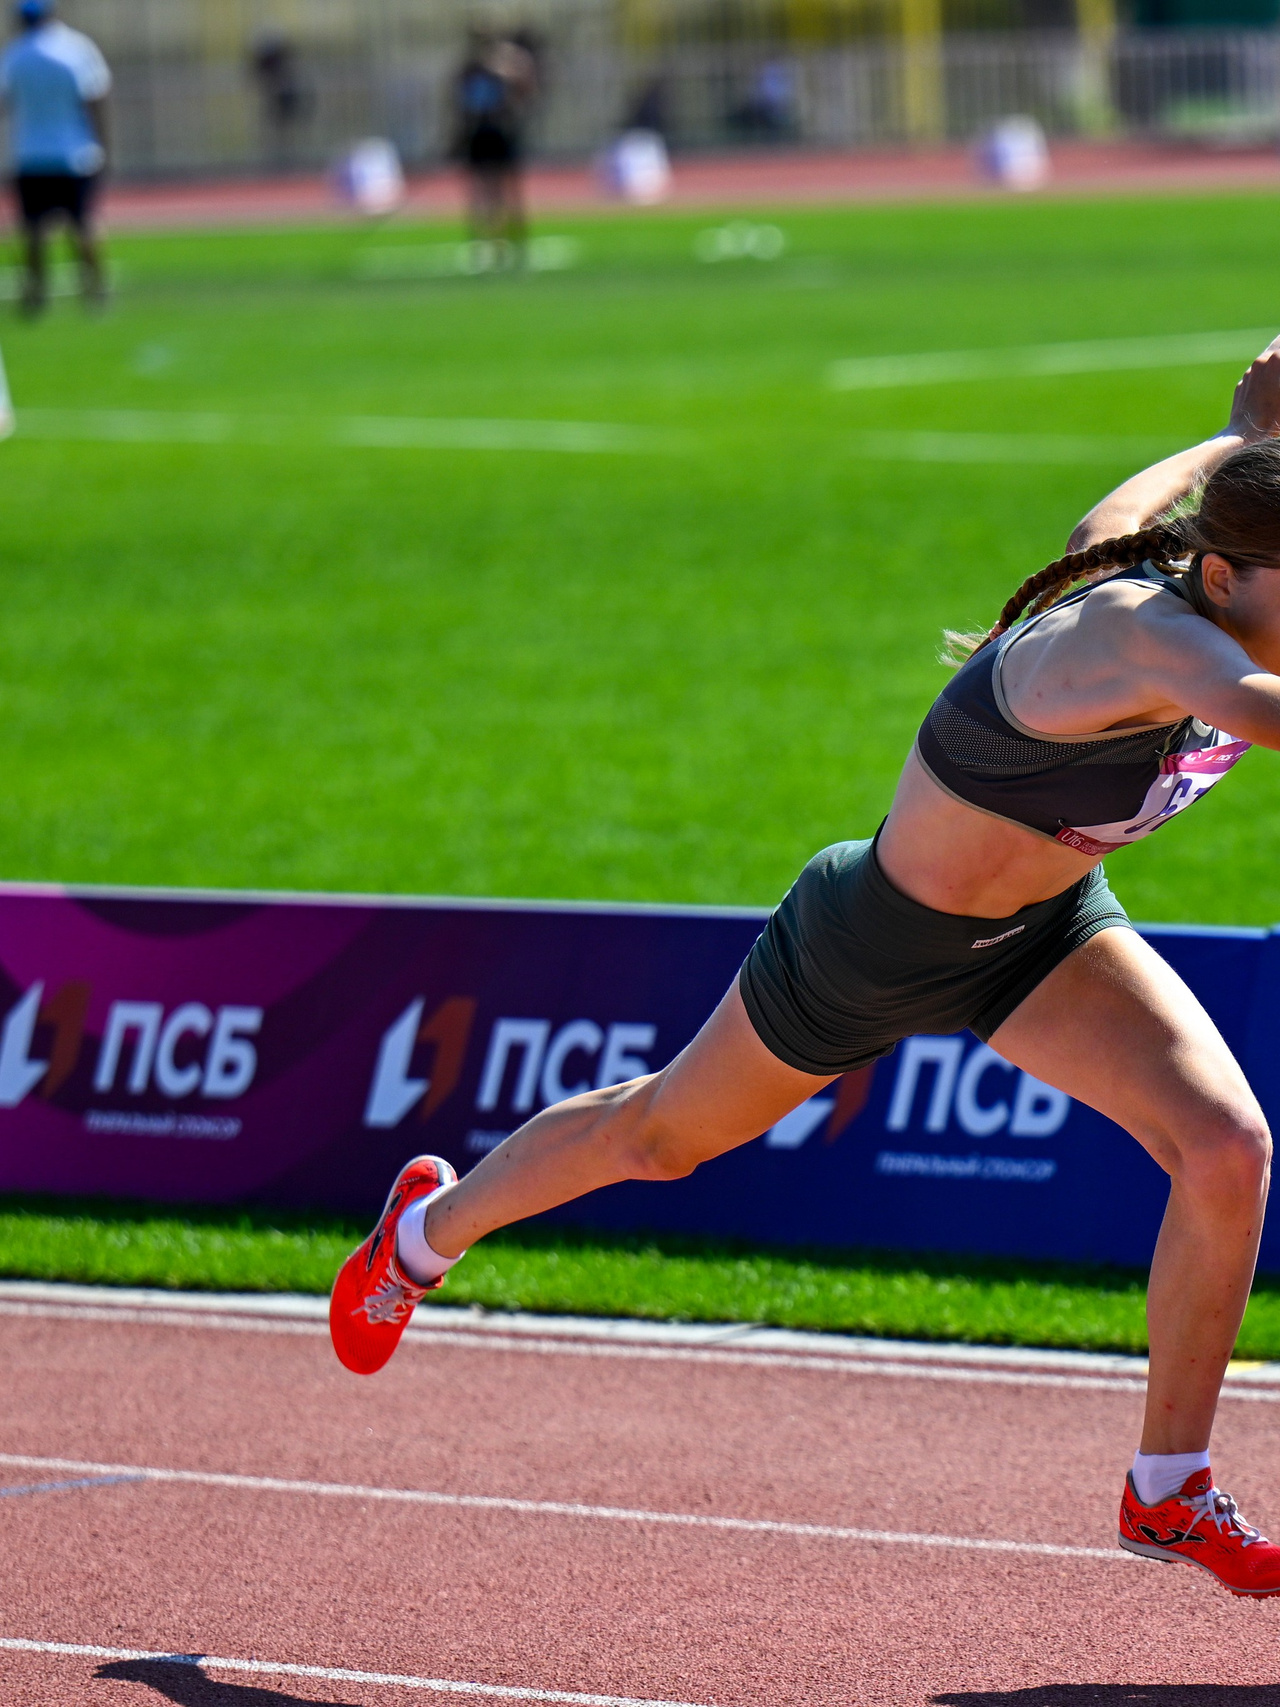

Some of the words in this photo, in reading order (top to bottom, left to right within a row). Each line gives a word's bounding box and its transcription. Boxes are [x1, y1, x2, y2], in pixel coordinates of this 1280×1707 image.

[1061, 831, 1085, 847] U16
[93, 1000, 263, 1098] ПСБ
[477, 1018, 656, 1113] ПСБ
